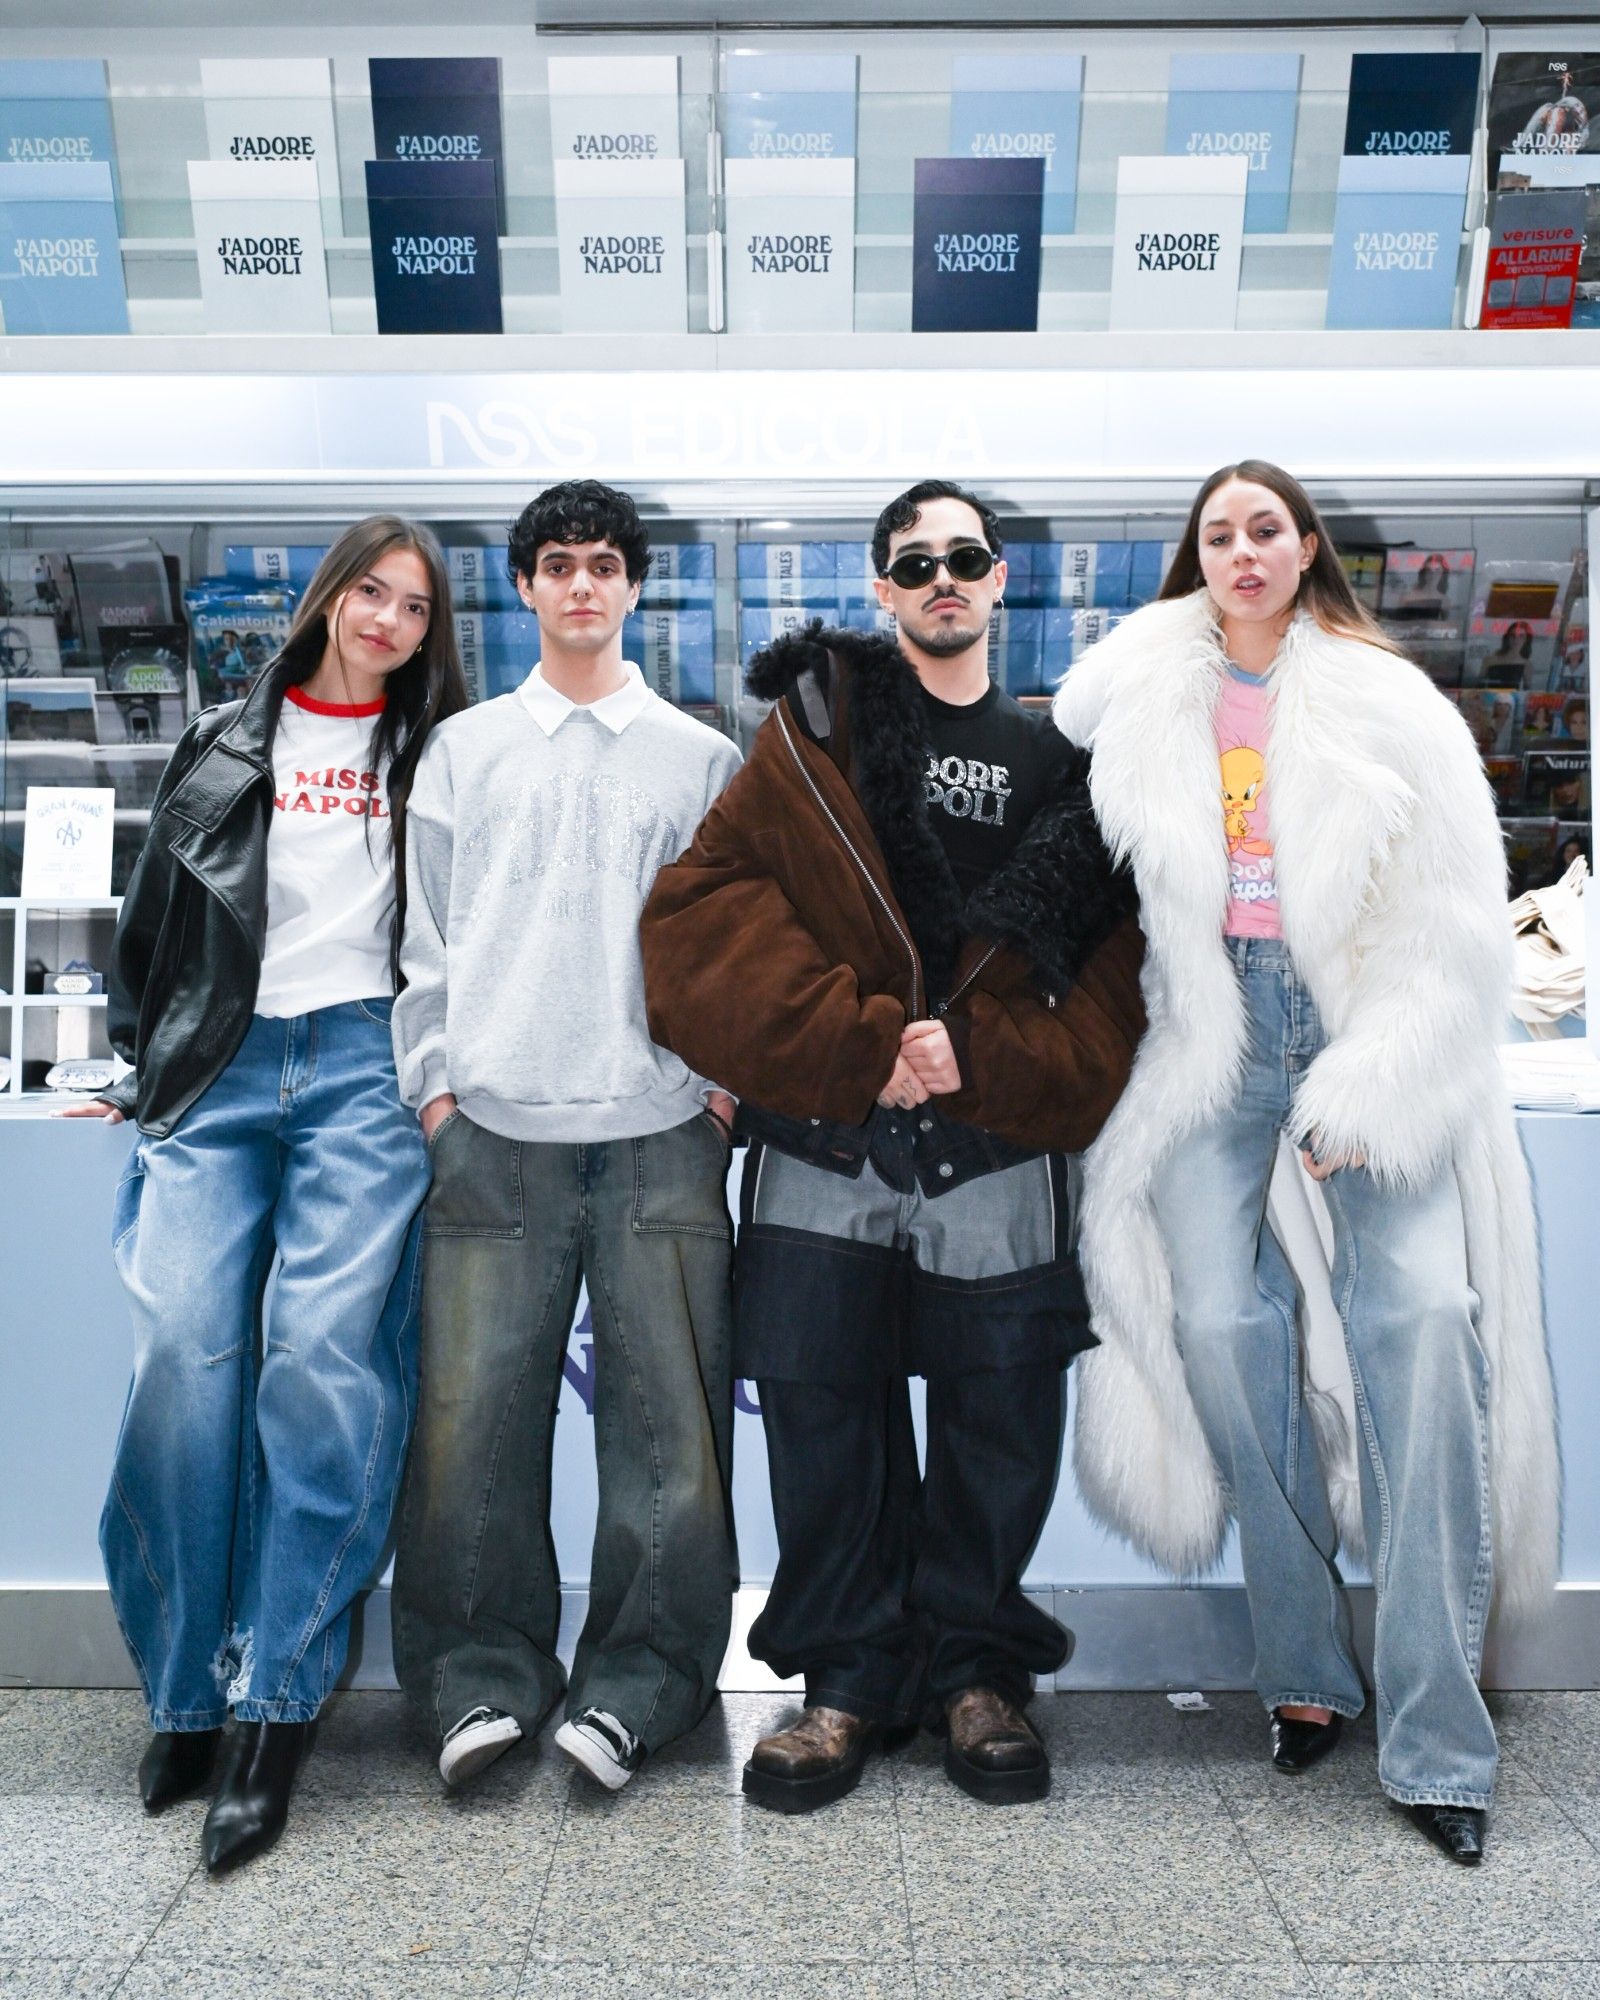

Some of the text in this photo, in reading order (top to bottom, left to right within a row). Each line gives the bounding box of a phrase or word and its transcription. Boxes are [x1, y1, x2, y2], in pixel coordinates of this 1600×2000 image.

[9, 138, 92, 155] J'ADORE
[230, 137, 315, 155] J'ADORE
[396, 136, 481, 154] J'ADORE
[573, 135, 657, 153] J'ADORE
[749, 134, 833, 152] J'ADORE
[972, 134, 1056, 152] J'ADORE
[1187, 133, 1271, 151] J'ADORE
[1366, 131, 1450, 149] J'ADORE
[1512, 132, 1582, 149] J'ADORE
[934, 234, 1019, 252] J'ADORE
[1136, 234, 1219, 251] J'ADORE
[1354, 233, 1438, 251] J'ADORE
[1503, 228, 1574, 241] verisure
[14, 239, 99, 256] J'ADORE
[218, 238, 302, 255] J'ADORE
[392, 237, 477, 255] J'ADORE
[580, 237, 664, 254] J'ADORE
[748, 236, 832, 253] J'ADORE
[397, 256, 474, 274] NAPOLI
[585, 256, 661, 273] NAPOLI
[752, 255, 828, 272] NAPOLI
[938, 254, 1015, 271] NAPOLI
[1139, 253, 1215, 270] NAPOLI
[1356, 252, 1434, 270] NAPOLI
[1496, 247, 1575, 265] ALLARME
[20, 258, 97, 275] NAPOLI
[223, 257, 300, 274] NAPOLI
[631, 400, 991, 466] EDICOLA
[462, 553, 476, 582] TALES
[657, 551, 671, 579] TALES
[780, 551, 793, 579] TALES
[1074, 549, 1089, 577] TALES
[197, 615, 274, 626] Calciatori
[461, 619, 475, 649] TALES
[656, 617, 670, 646] TALES
[294, 768, 379, 792] MISS
[36, 799, 105, 818] GRAN FINALE
